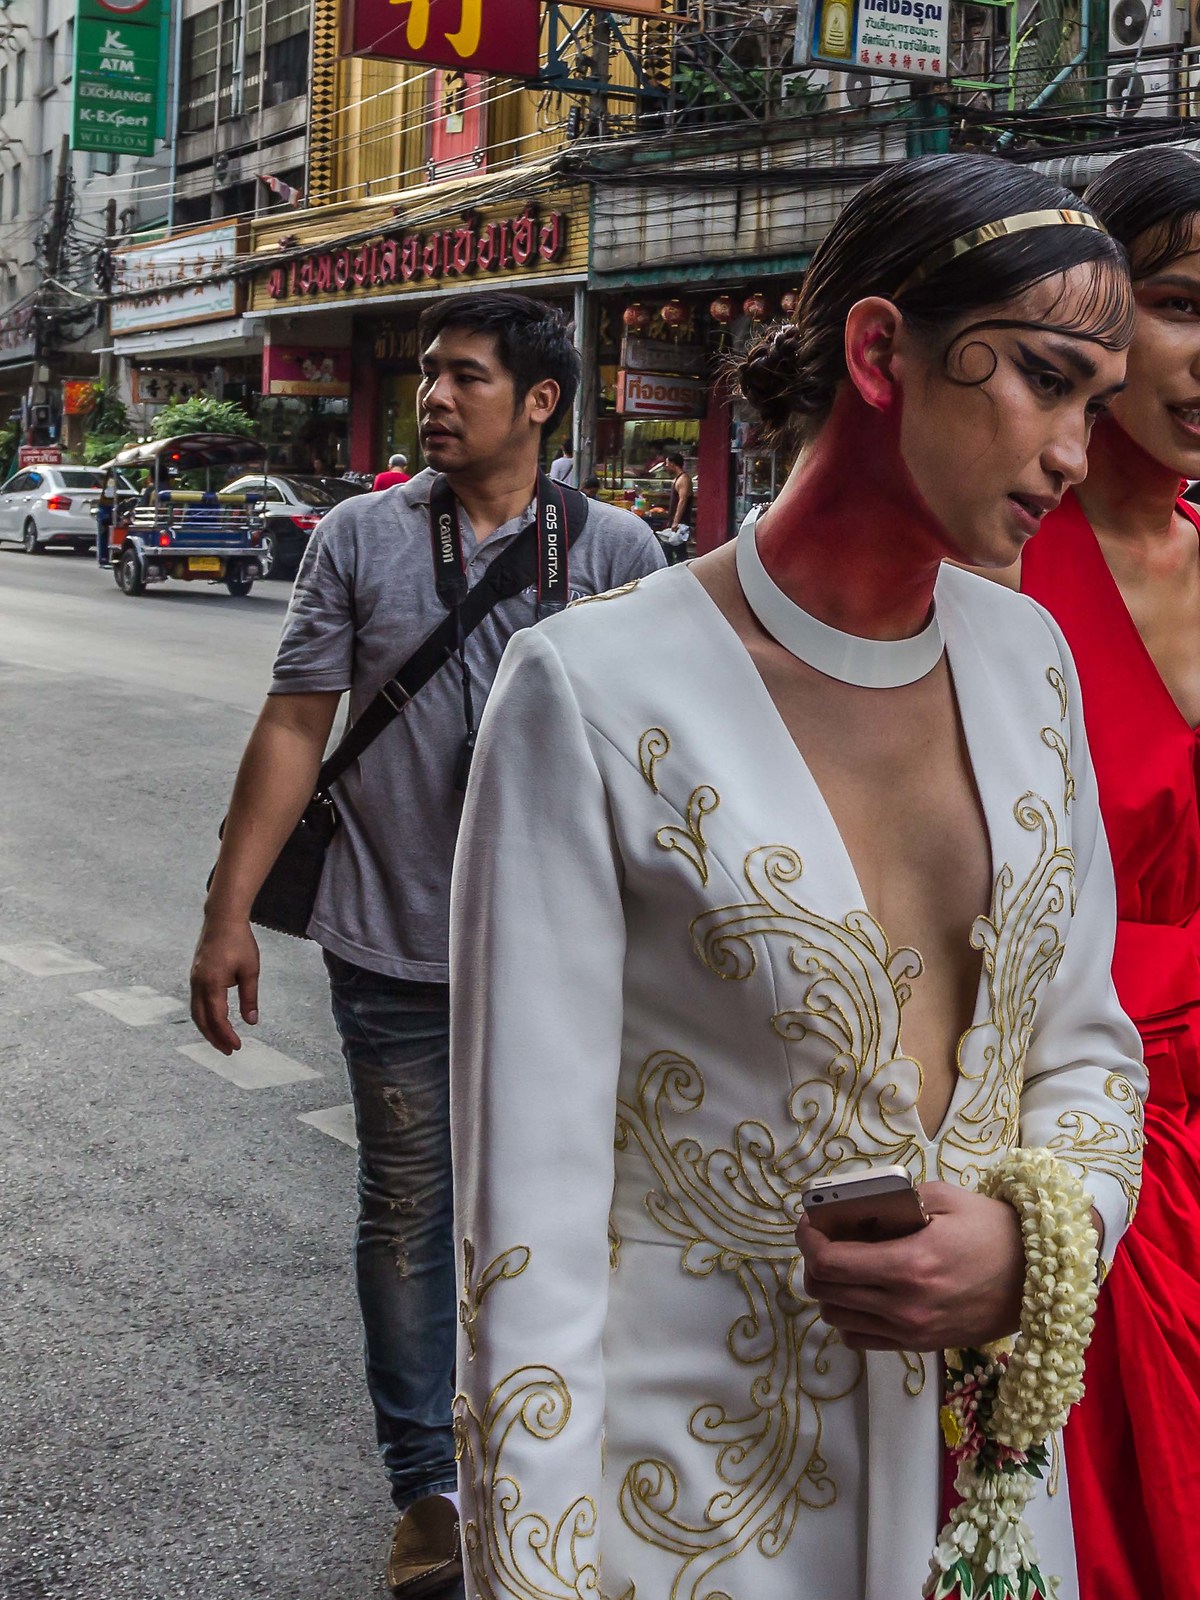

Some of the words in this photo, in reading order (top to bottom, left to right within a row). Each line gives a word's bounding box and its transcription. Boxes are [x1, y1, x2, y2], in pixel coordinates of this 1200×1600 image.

[99, 58, 135, 73] ATM
[80, 86, 152, 103] EXCHANGE
[81, 132, 147, 147] WISDOM
[546, 504, 558, 530] EOS
[438, 513, 454, 563] Canon
[548, 533, 559, 588] DIGITAL
